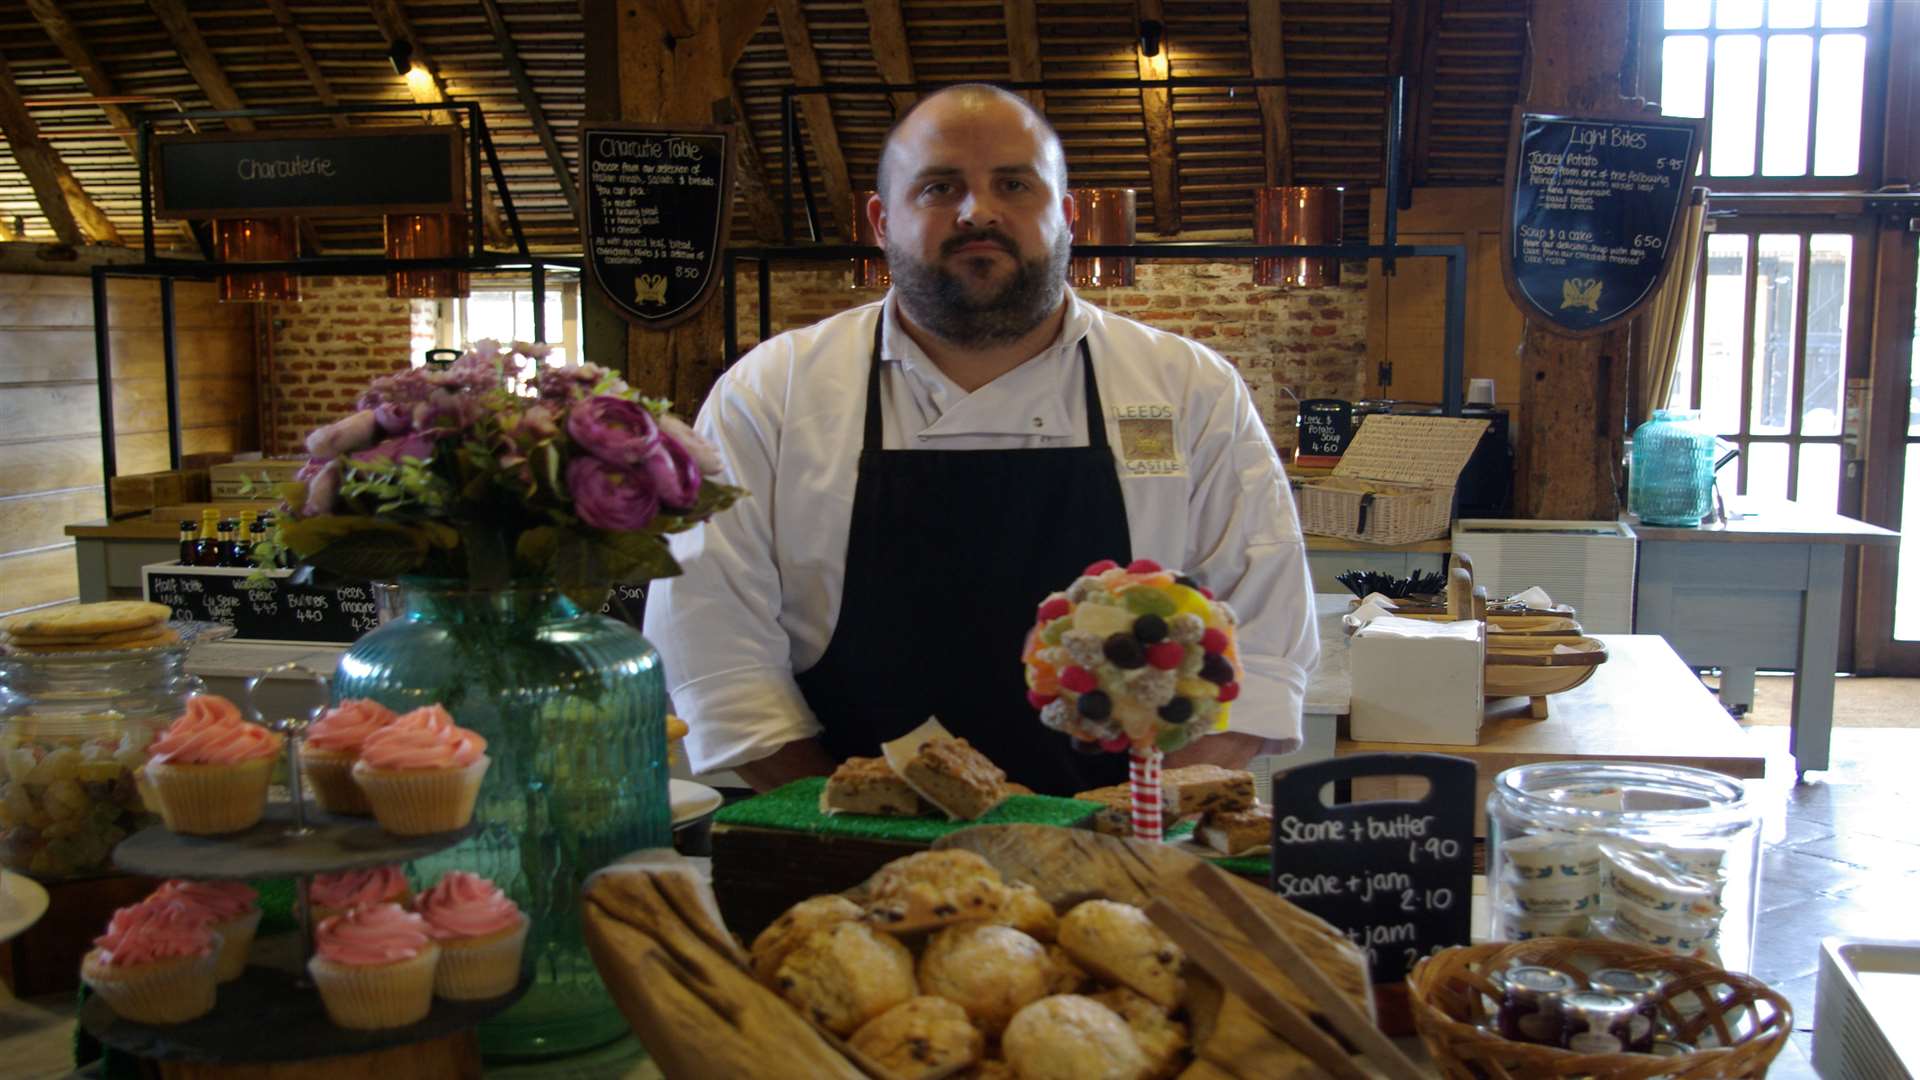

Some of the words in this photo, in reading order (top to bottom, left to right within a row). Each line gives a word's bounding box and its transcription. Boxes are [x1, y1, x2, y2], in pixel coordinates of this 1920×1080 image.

[1570, 125, 1607, 153] Light
[1611, 127, 1648, 150] Bites
[664, 136, 704, 161] Table
[592, 161, 620, 172] Choose
[621, 162, 640, 173] from
[690, 164, 702, 174] of
[1527, 151, 1564, 166] Jacket
[1566, 152, 1599, 167] Potato
[238, 155, 337, 181] Charcuterie
[1559, 166, 1579, 177] from
[1580, 168, 1598, 178] one
[1610, 171, 1627, 181] the
[1628, 170, 1671, 188] following
[595, 184, 611, 196] You
[612, 187, 627, 195] can
[1520, 224, 1546, 240] Soup
[1557, 229, 1566, 240] a
[1568, 230, 1595, 242] cake
[1118, 405, 1173, 418] LEEDS
[1308, 424, 1335, 436] Potato
[1320, 433, 1342, 444] Soup
[1126, 460, 1181, 471] CASTLE
[153, 576, 178, 593] Half
[1279, 814, 1346, 845] Scone
[1349, 821, 1364, 843] +
[1366, 813, 1435, 840] butter
[1277, 872, 1342, 897] Scone
[1345, 873, 1361, 892] +
[1360, 869, 1410, 902] jam
[1363, 921, 1415, 949] jam
